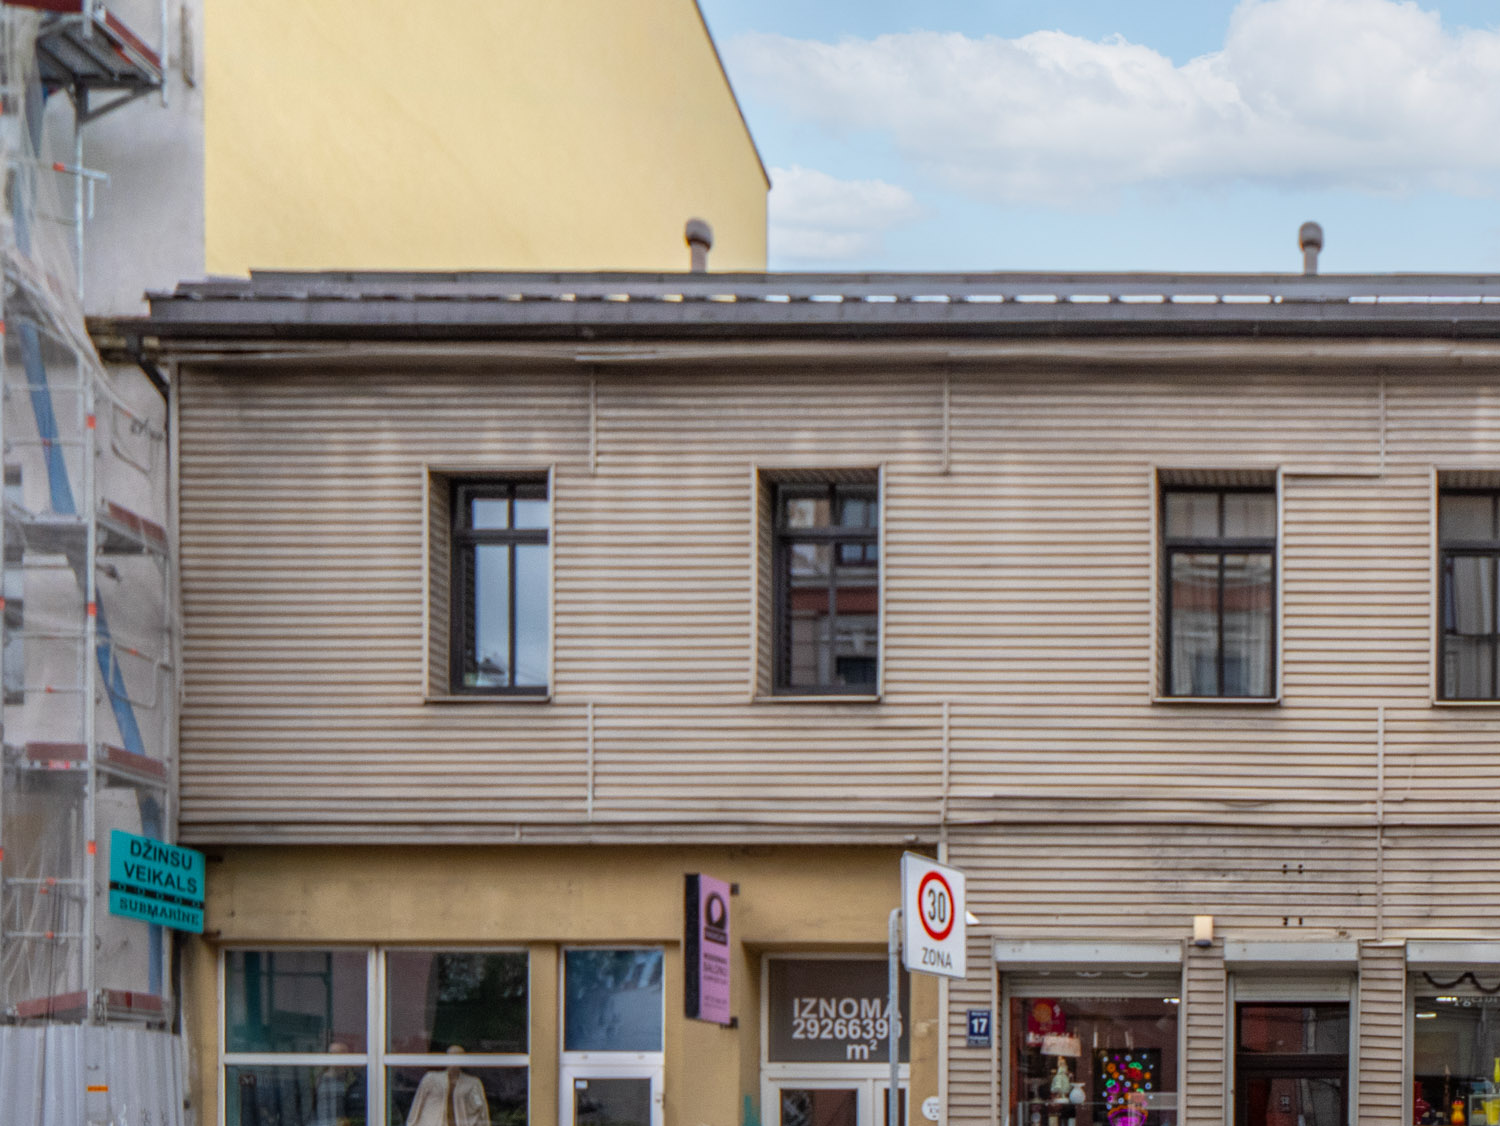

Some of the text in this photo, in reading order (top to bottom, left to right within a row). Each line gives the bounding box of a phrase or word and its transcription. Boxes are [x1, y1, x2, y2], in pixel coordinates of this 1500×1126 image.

[130, 838, 192, 870] DŽINSU
[123, 861, 197, 894] VEIKALS
[120, 897, 199, 926] SUBMARĪNE
[927, 888, 947, 924] 30
[921, 947, 953, 969] ZONA
[792, 1018, 903, 1039] 2926639
[971, 1018, 987, 1034] 17
